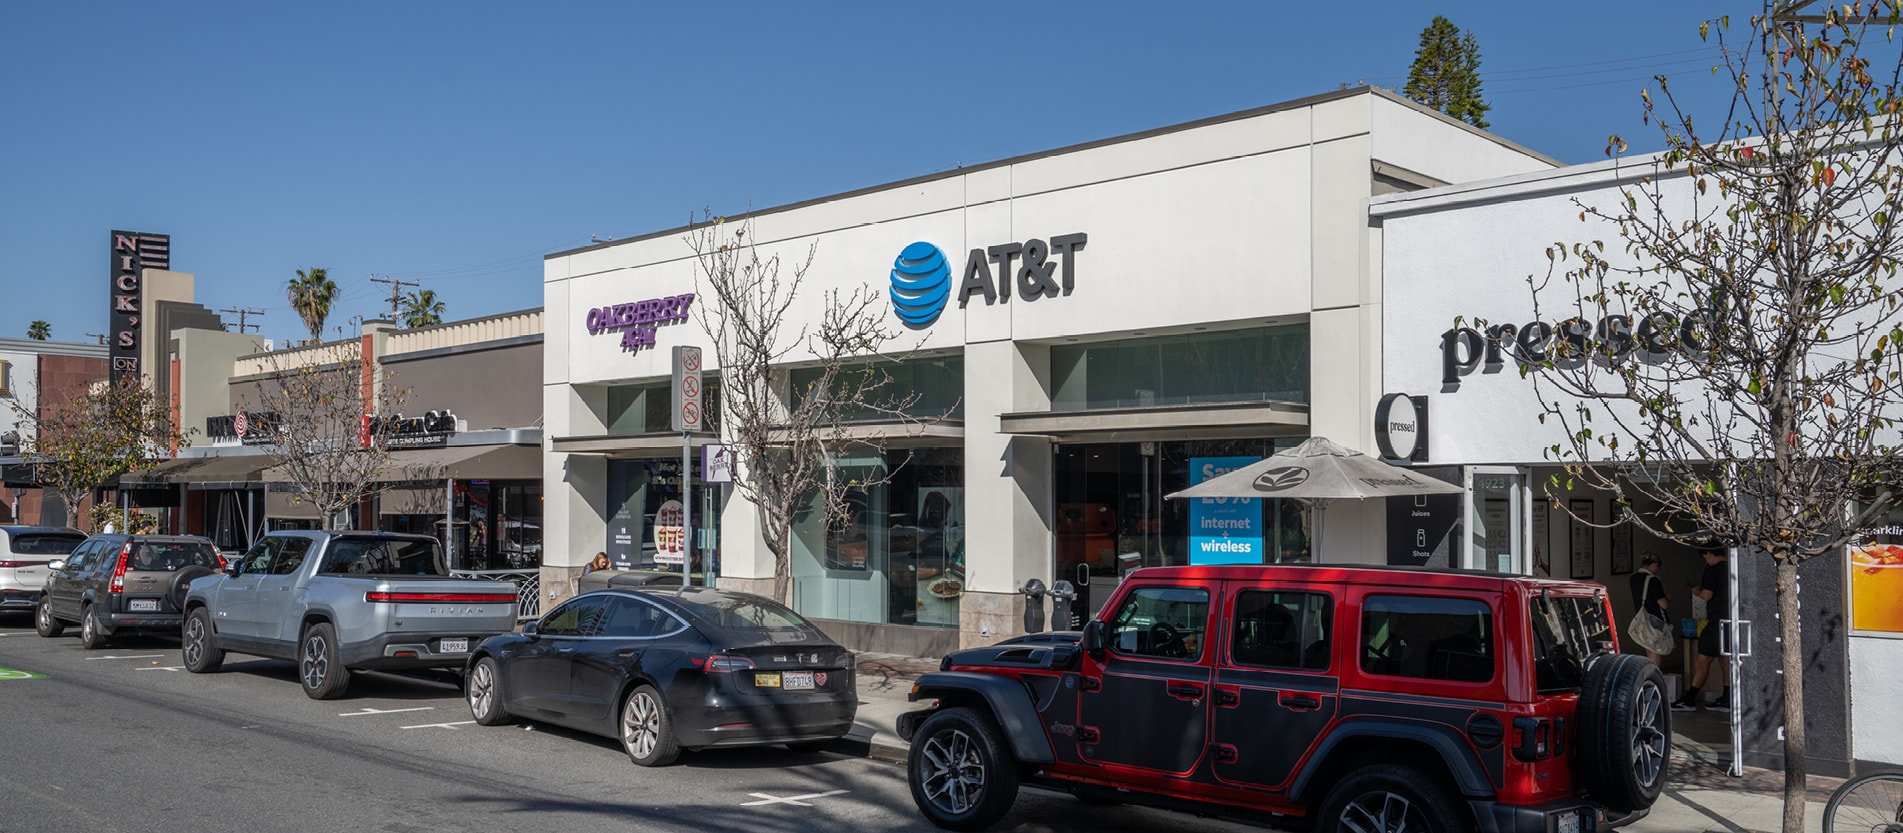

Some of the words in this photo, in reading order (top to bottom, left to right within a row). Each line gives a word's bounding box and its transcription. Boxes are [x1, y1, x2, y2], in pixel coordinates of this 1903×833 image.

[957, 232, 1088, 302] AT&T
[115, 234, 138, 347] NICK'S
[586, 293, 696, 333] OAKBERRY
[1440, 285, 1730, 388] pressed
[115, 359, 137, 370] ON
[1389, 419, 1416, 435] pressed
[709, 463, 728, 471] BERR
[712, 457, 726, 465] OAK
[1478, 478, 1506, 489] 4923
[1411, 509, 1431, 518] Juices
[1200, 516, 1251, 529] internet
[1200, 540, 1252, 553] wireless
[1412, 550, 1430, 558] Shots
